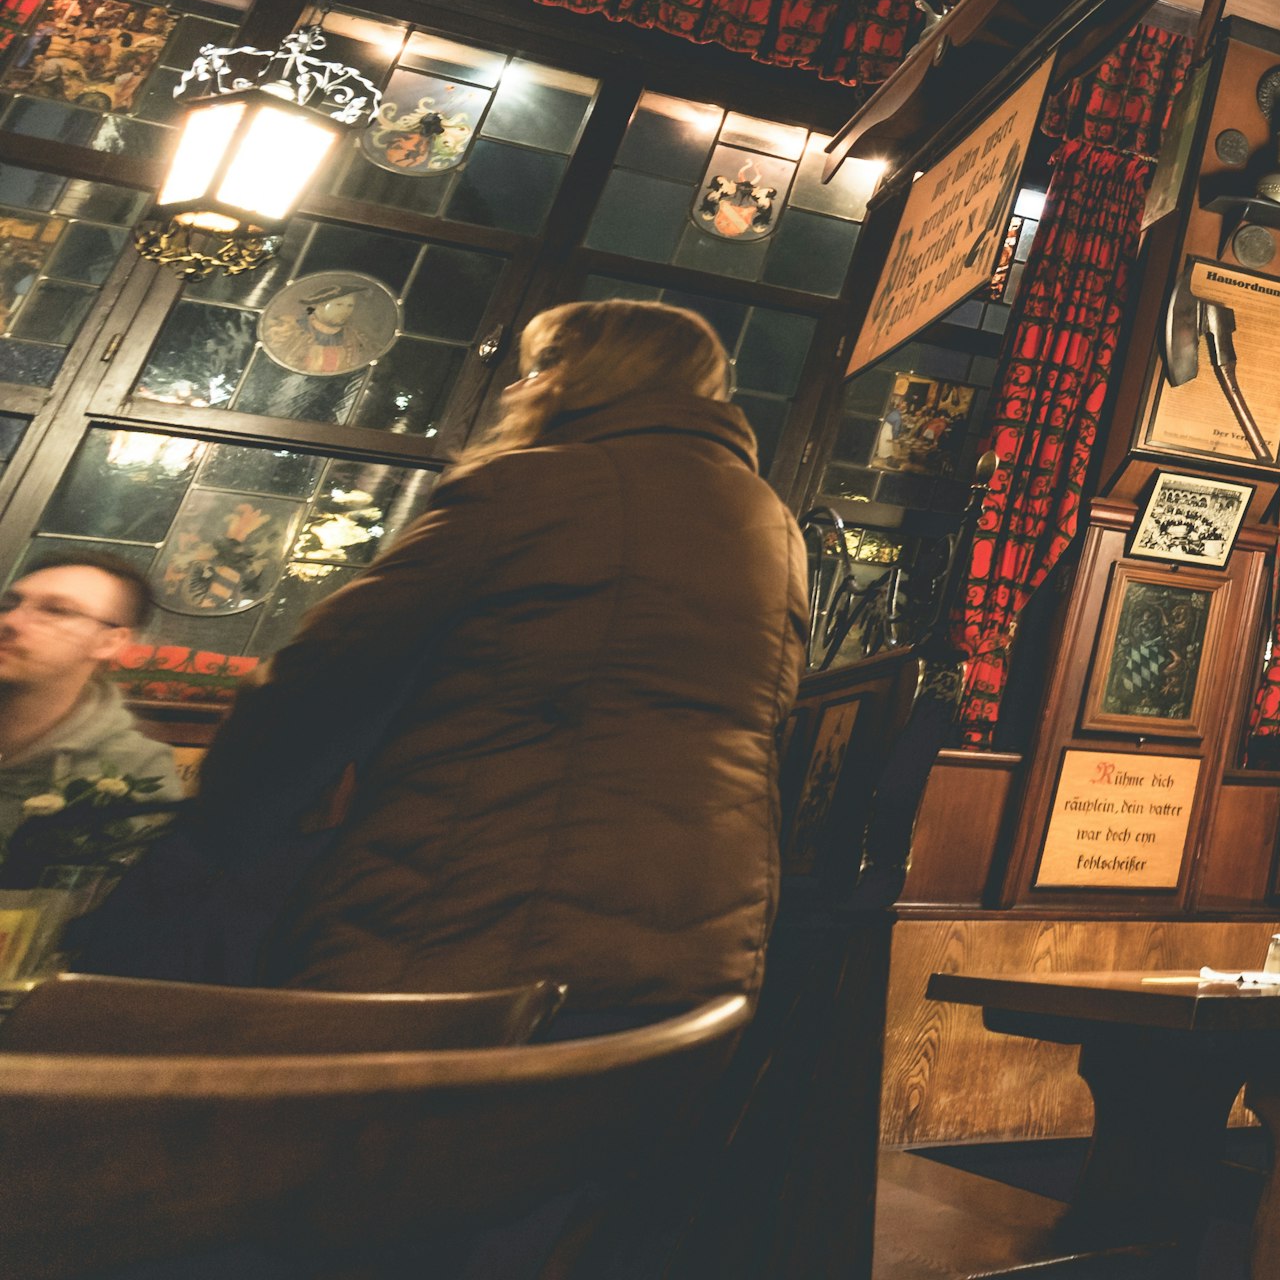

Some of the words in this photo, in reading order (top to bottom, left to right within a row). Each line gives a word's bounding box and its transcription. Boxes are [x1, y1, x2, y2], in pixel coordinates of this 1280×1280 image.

[1213, 429, 1229, 437] Der
[1090, 762, 1144, 788] Rühme
[1151, 774, 1174, 788] dich
[1121, 800, 1143, 814] dein
[1077, 828, 1101, 840] war
[1106, 827, 1131, 843] doch
